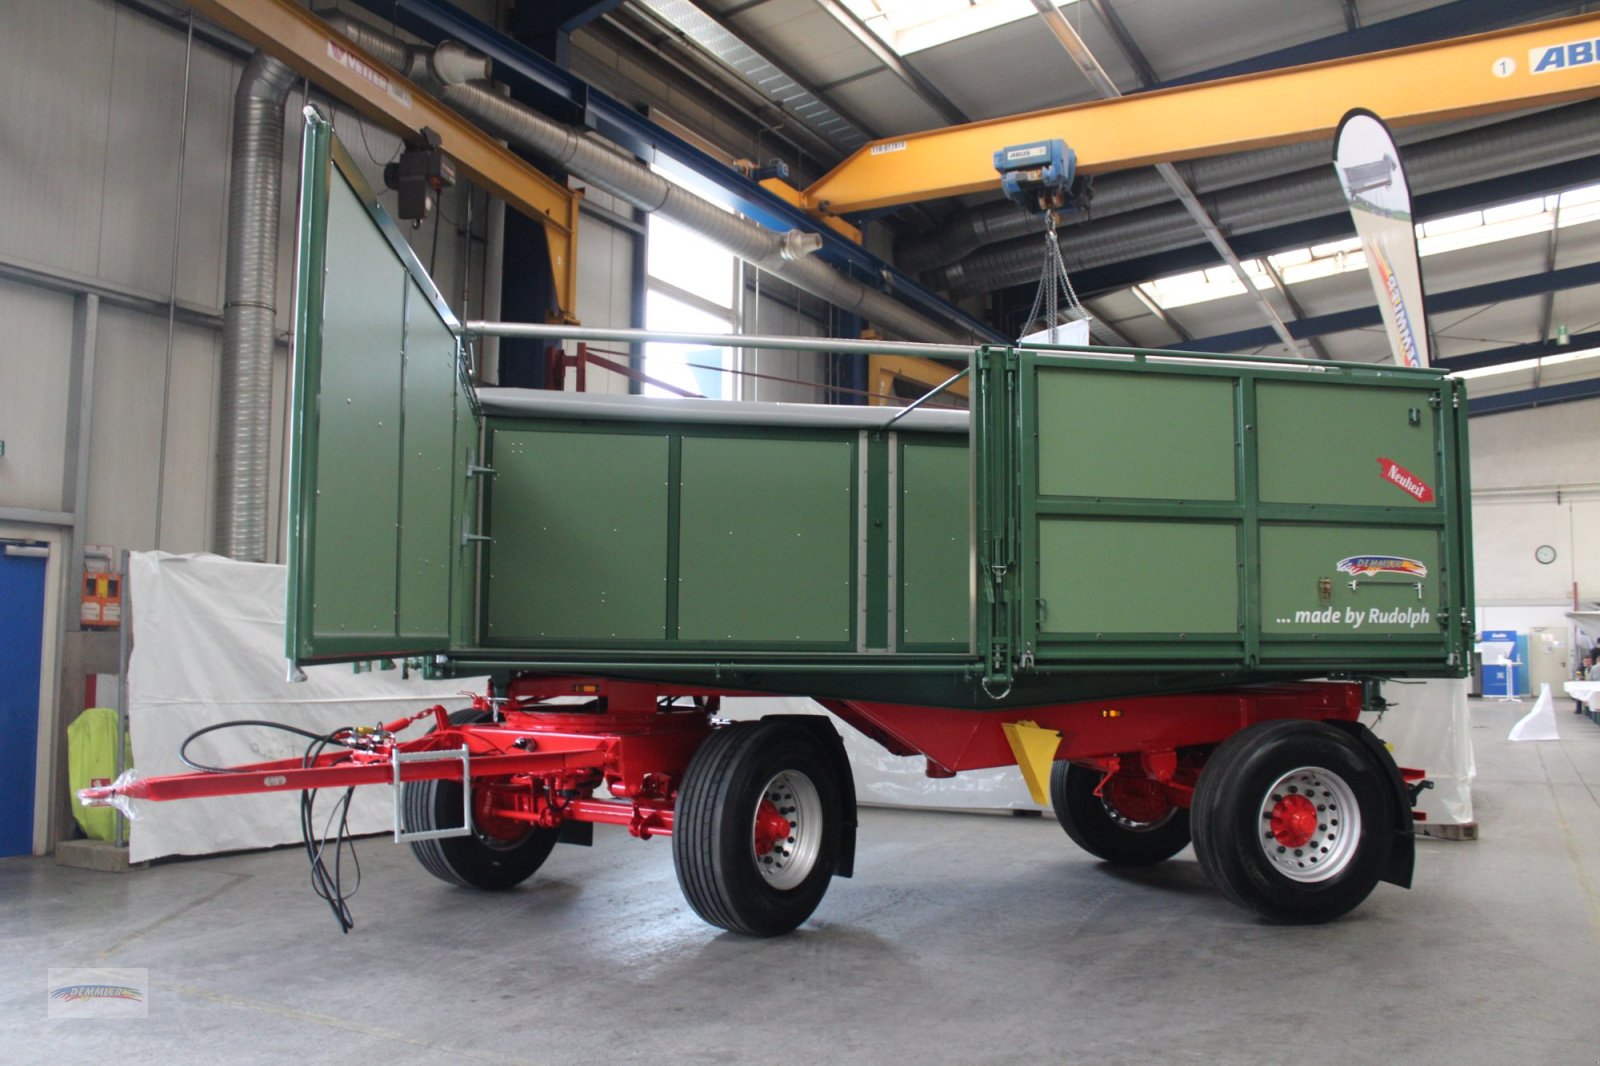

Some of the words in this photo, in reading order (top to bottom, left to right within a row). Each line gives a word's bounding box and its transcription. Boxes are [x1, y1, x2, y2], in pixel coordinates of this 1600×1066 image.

[1499, 61, 1506, 75] 1
[1009, 150, 1031, 159] ABUS
[1388, 464, 1426, 498] Neuheit
[1295, 607, 1341, 624] made
[1345, 606, 1365, 629] by
[1368, 607, 1430, 628] Rudolph
